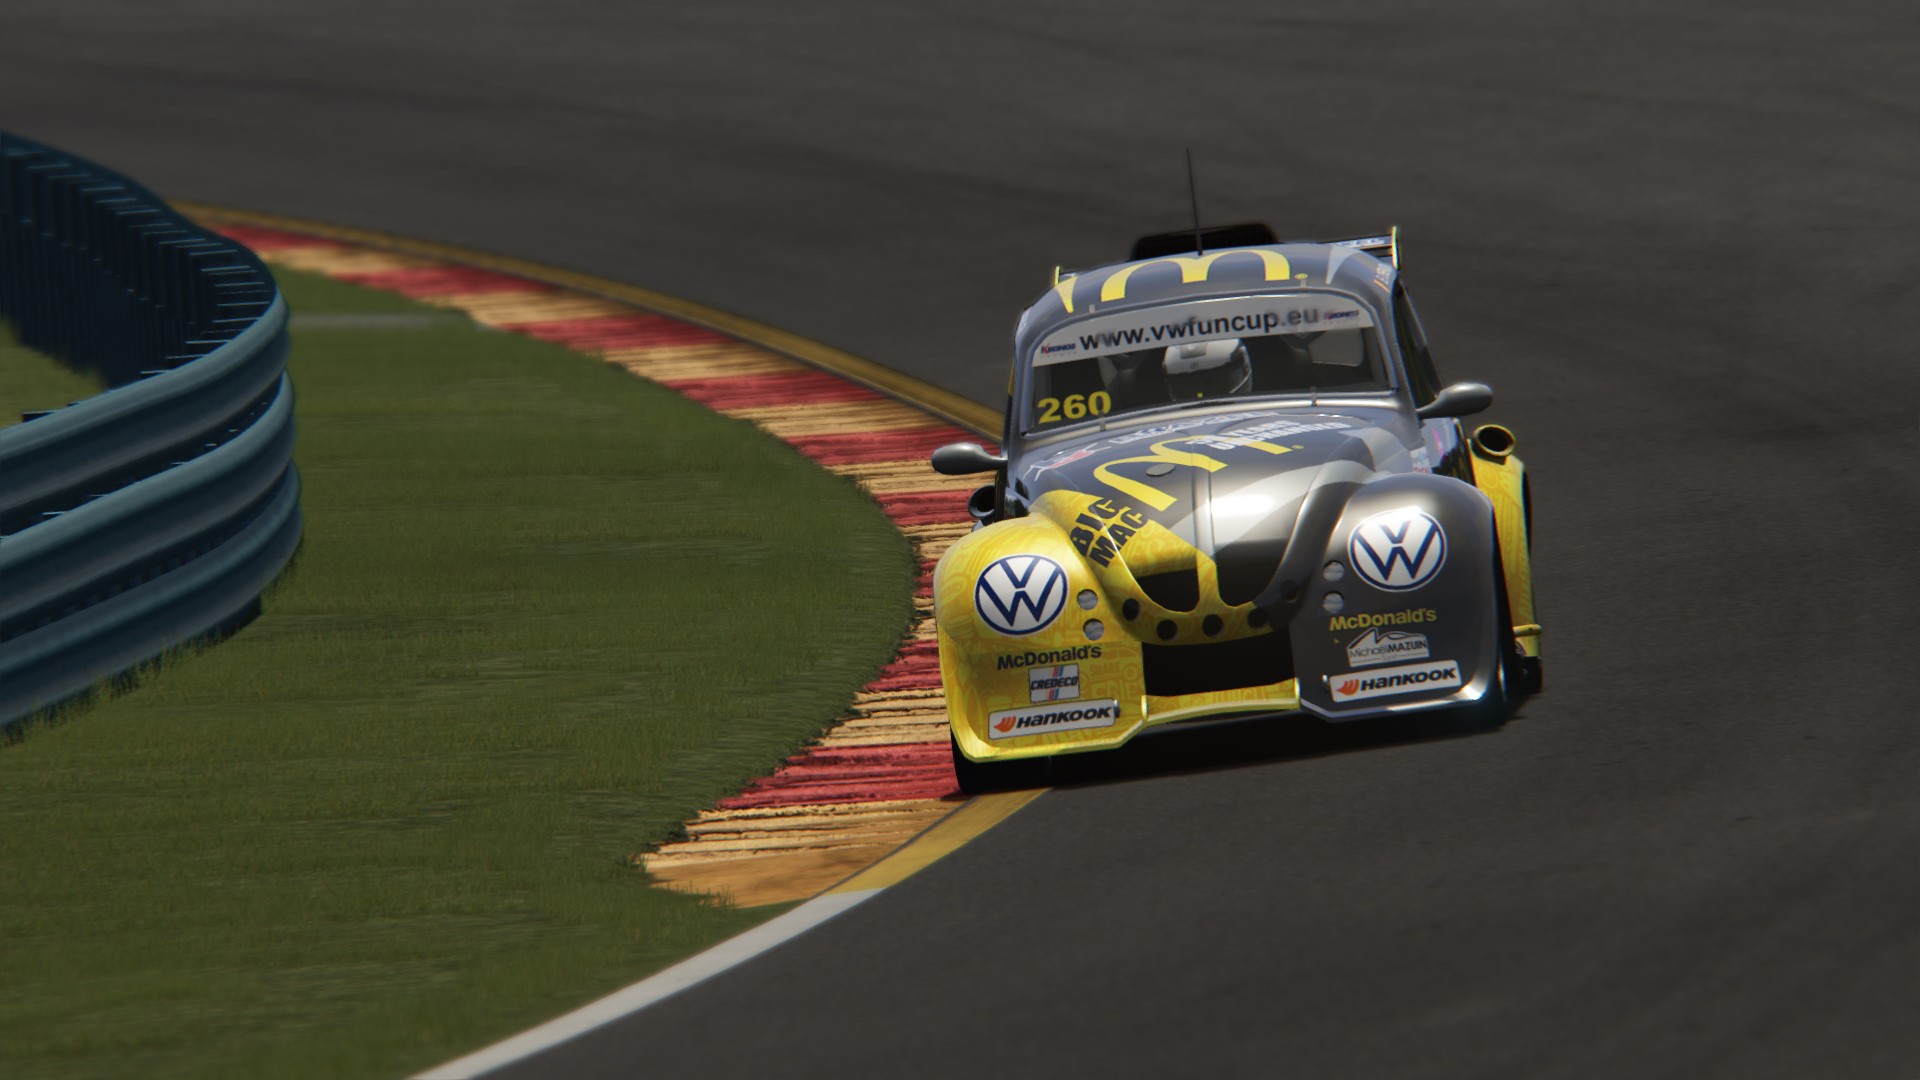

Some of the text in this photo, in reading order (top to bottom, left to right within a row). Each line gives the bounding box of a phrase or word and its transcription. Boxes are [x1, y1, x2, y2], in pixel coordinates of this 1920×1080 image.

[1080, 308, 1318, 350] www.vwfuncup.eu
[1037, 390, 1112, 424] 260
[1070, 499, 1121, 557] BIG
[1089, 511, 1149, 568] MAC
[1329, 608, 1437, 631] McDonald's
[997, 646, 1102, 671] McDonald's
[1030, 676, 1079, 691] CREDECO
